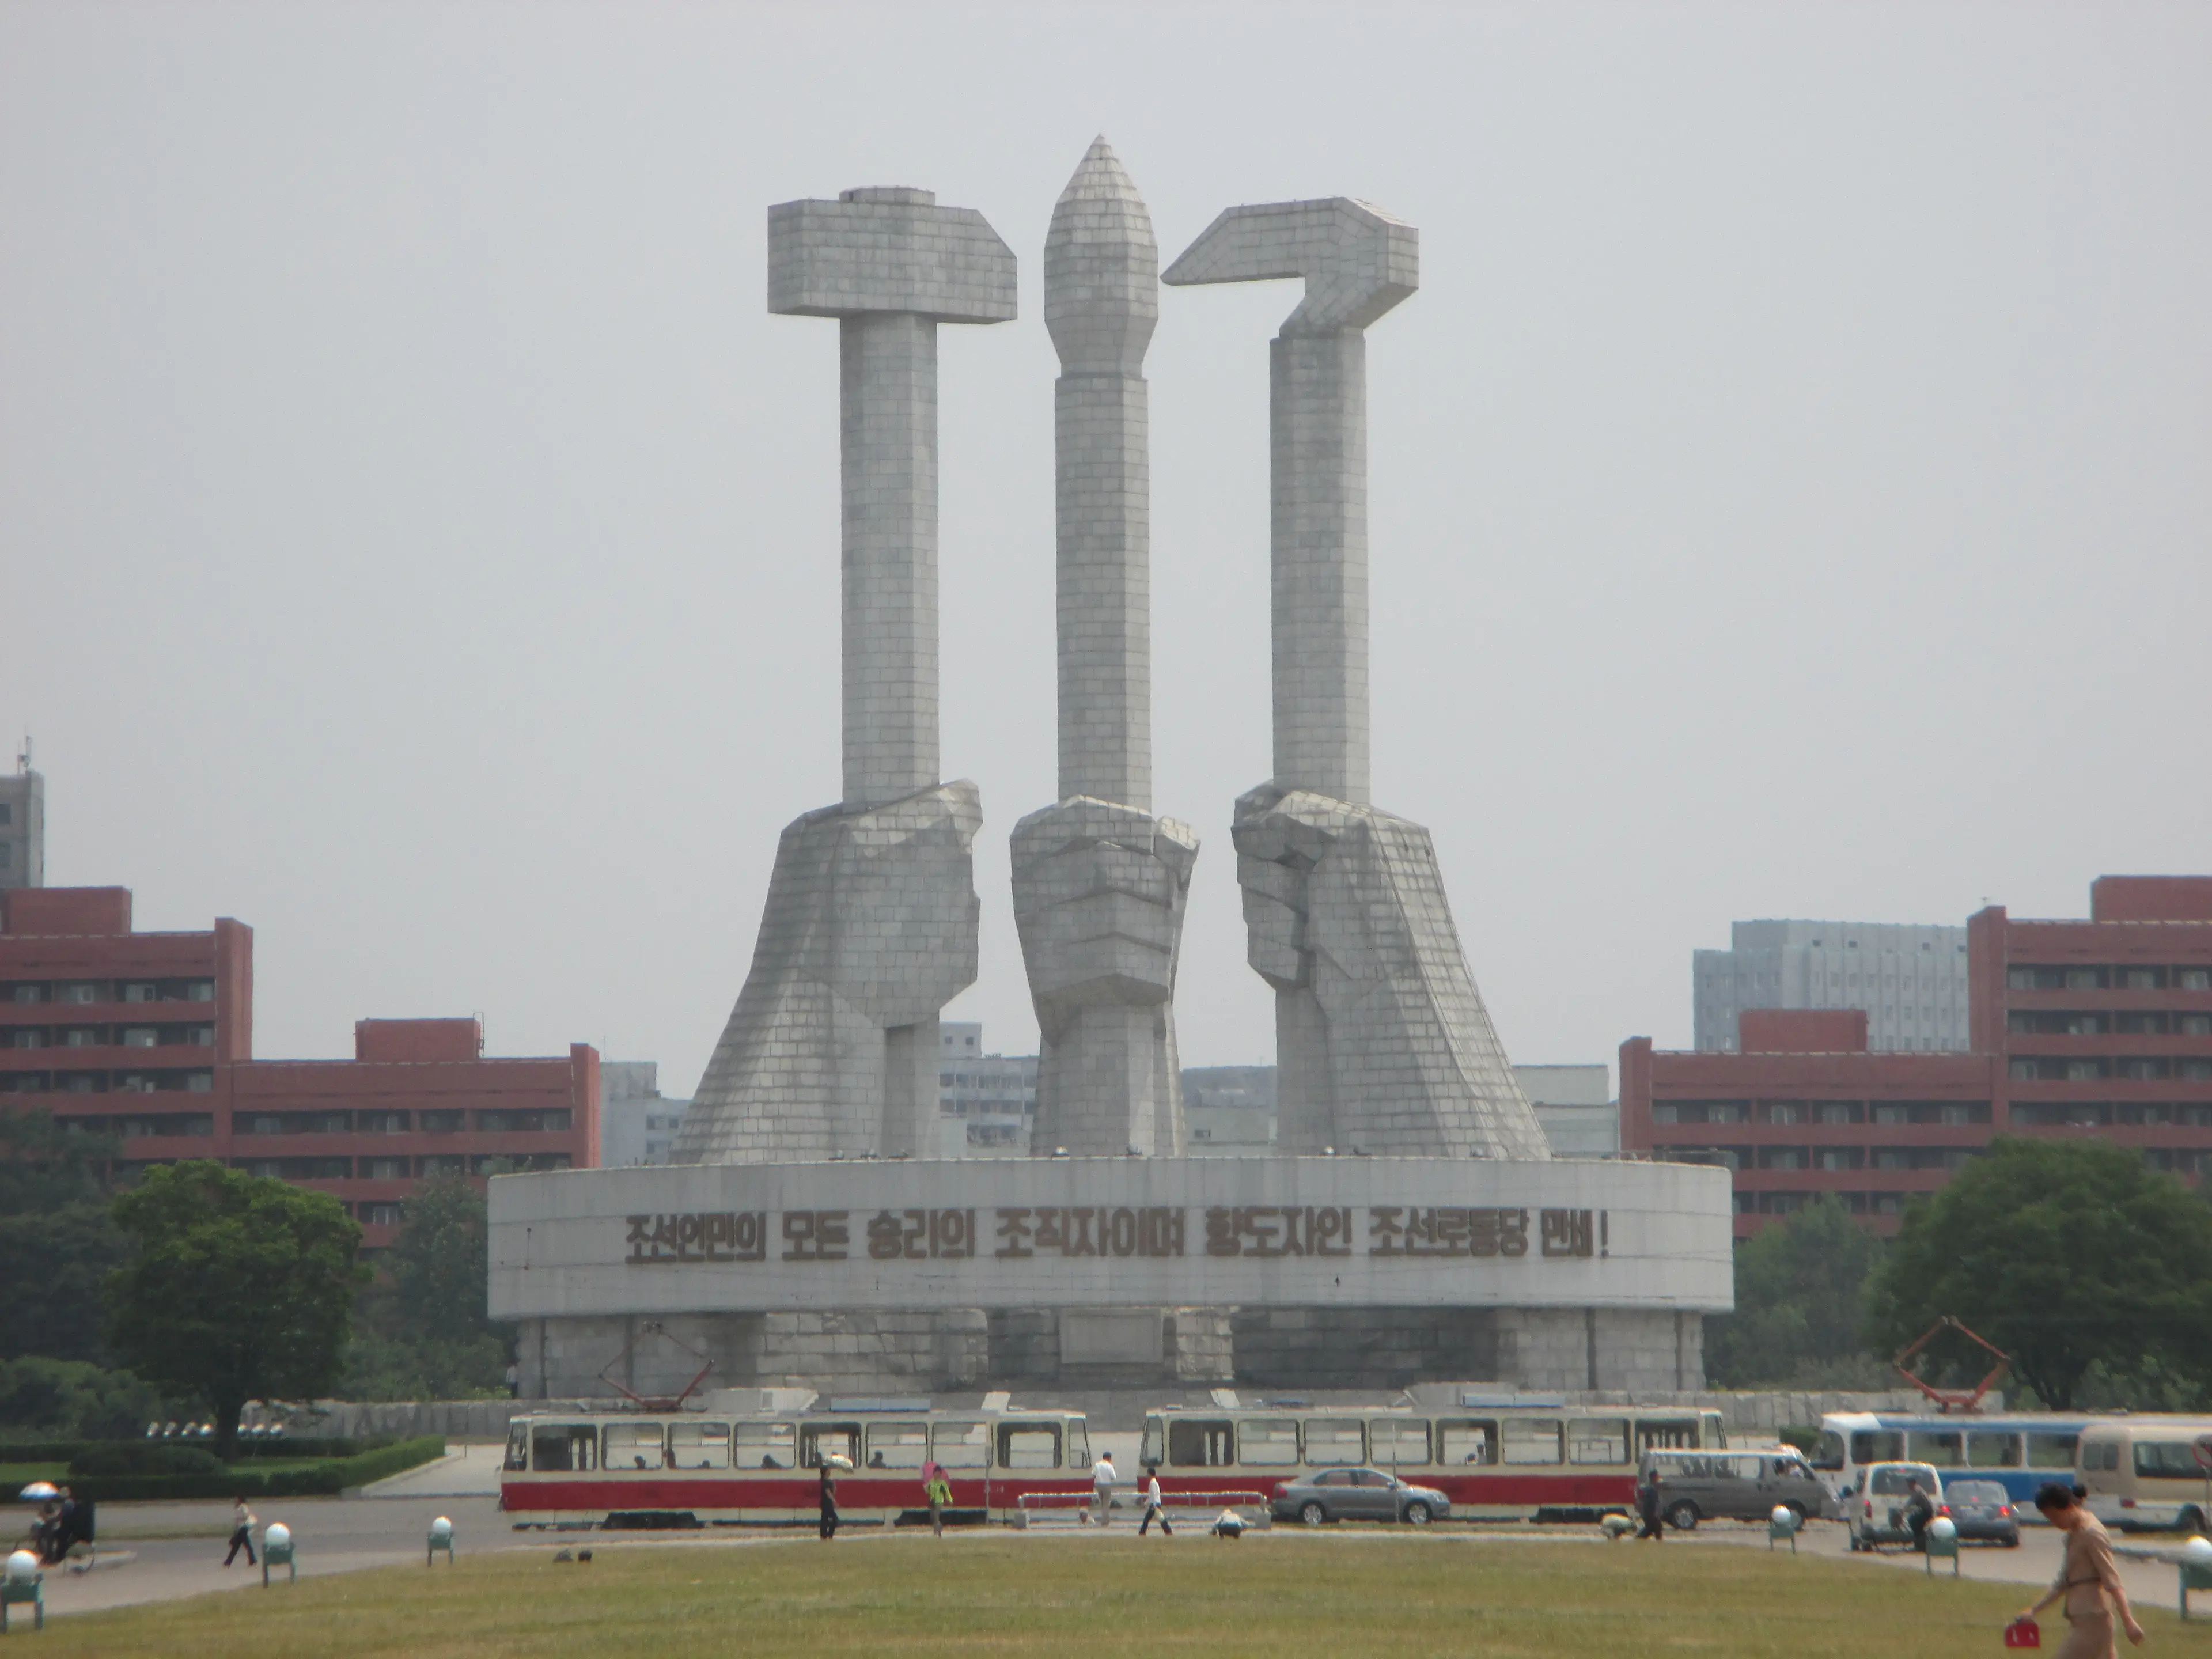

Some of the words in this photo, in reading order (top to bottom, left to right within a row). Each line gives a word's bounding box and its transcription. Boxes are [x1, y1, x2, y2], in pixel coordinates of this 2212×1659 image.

[625, 1210, 767, 1264] 조선인민의
[782, 1210, 850, 1261] 모든
[867, 1208, 975, 1259] 승리의
[994, 1207, 1185, 1258] 조직자이며
[1205, 1206, 1352, 1258] 향도자인
[1369, 1206, 1529, 1258] 조선로동당
